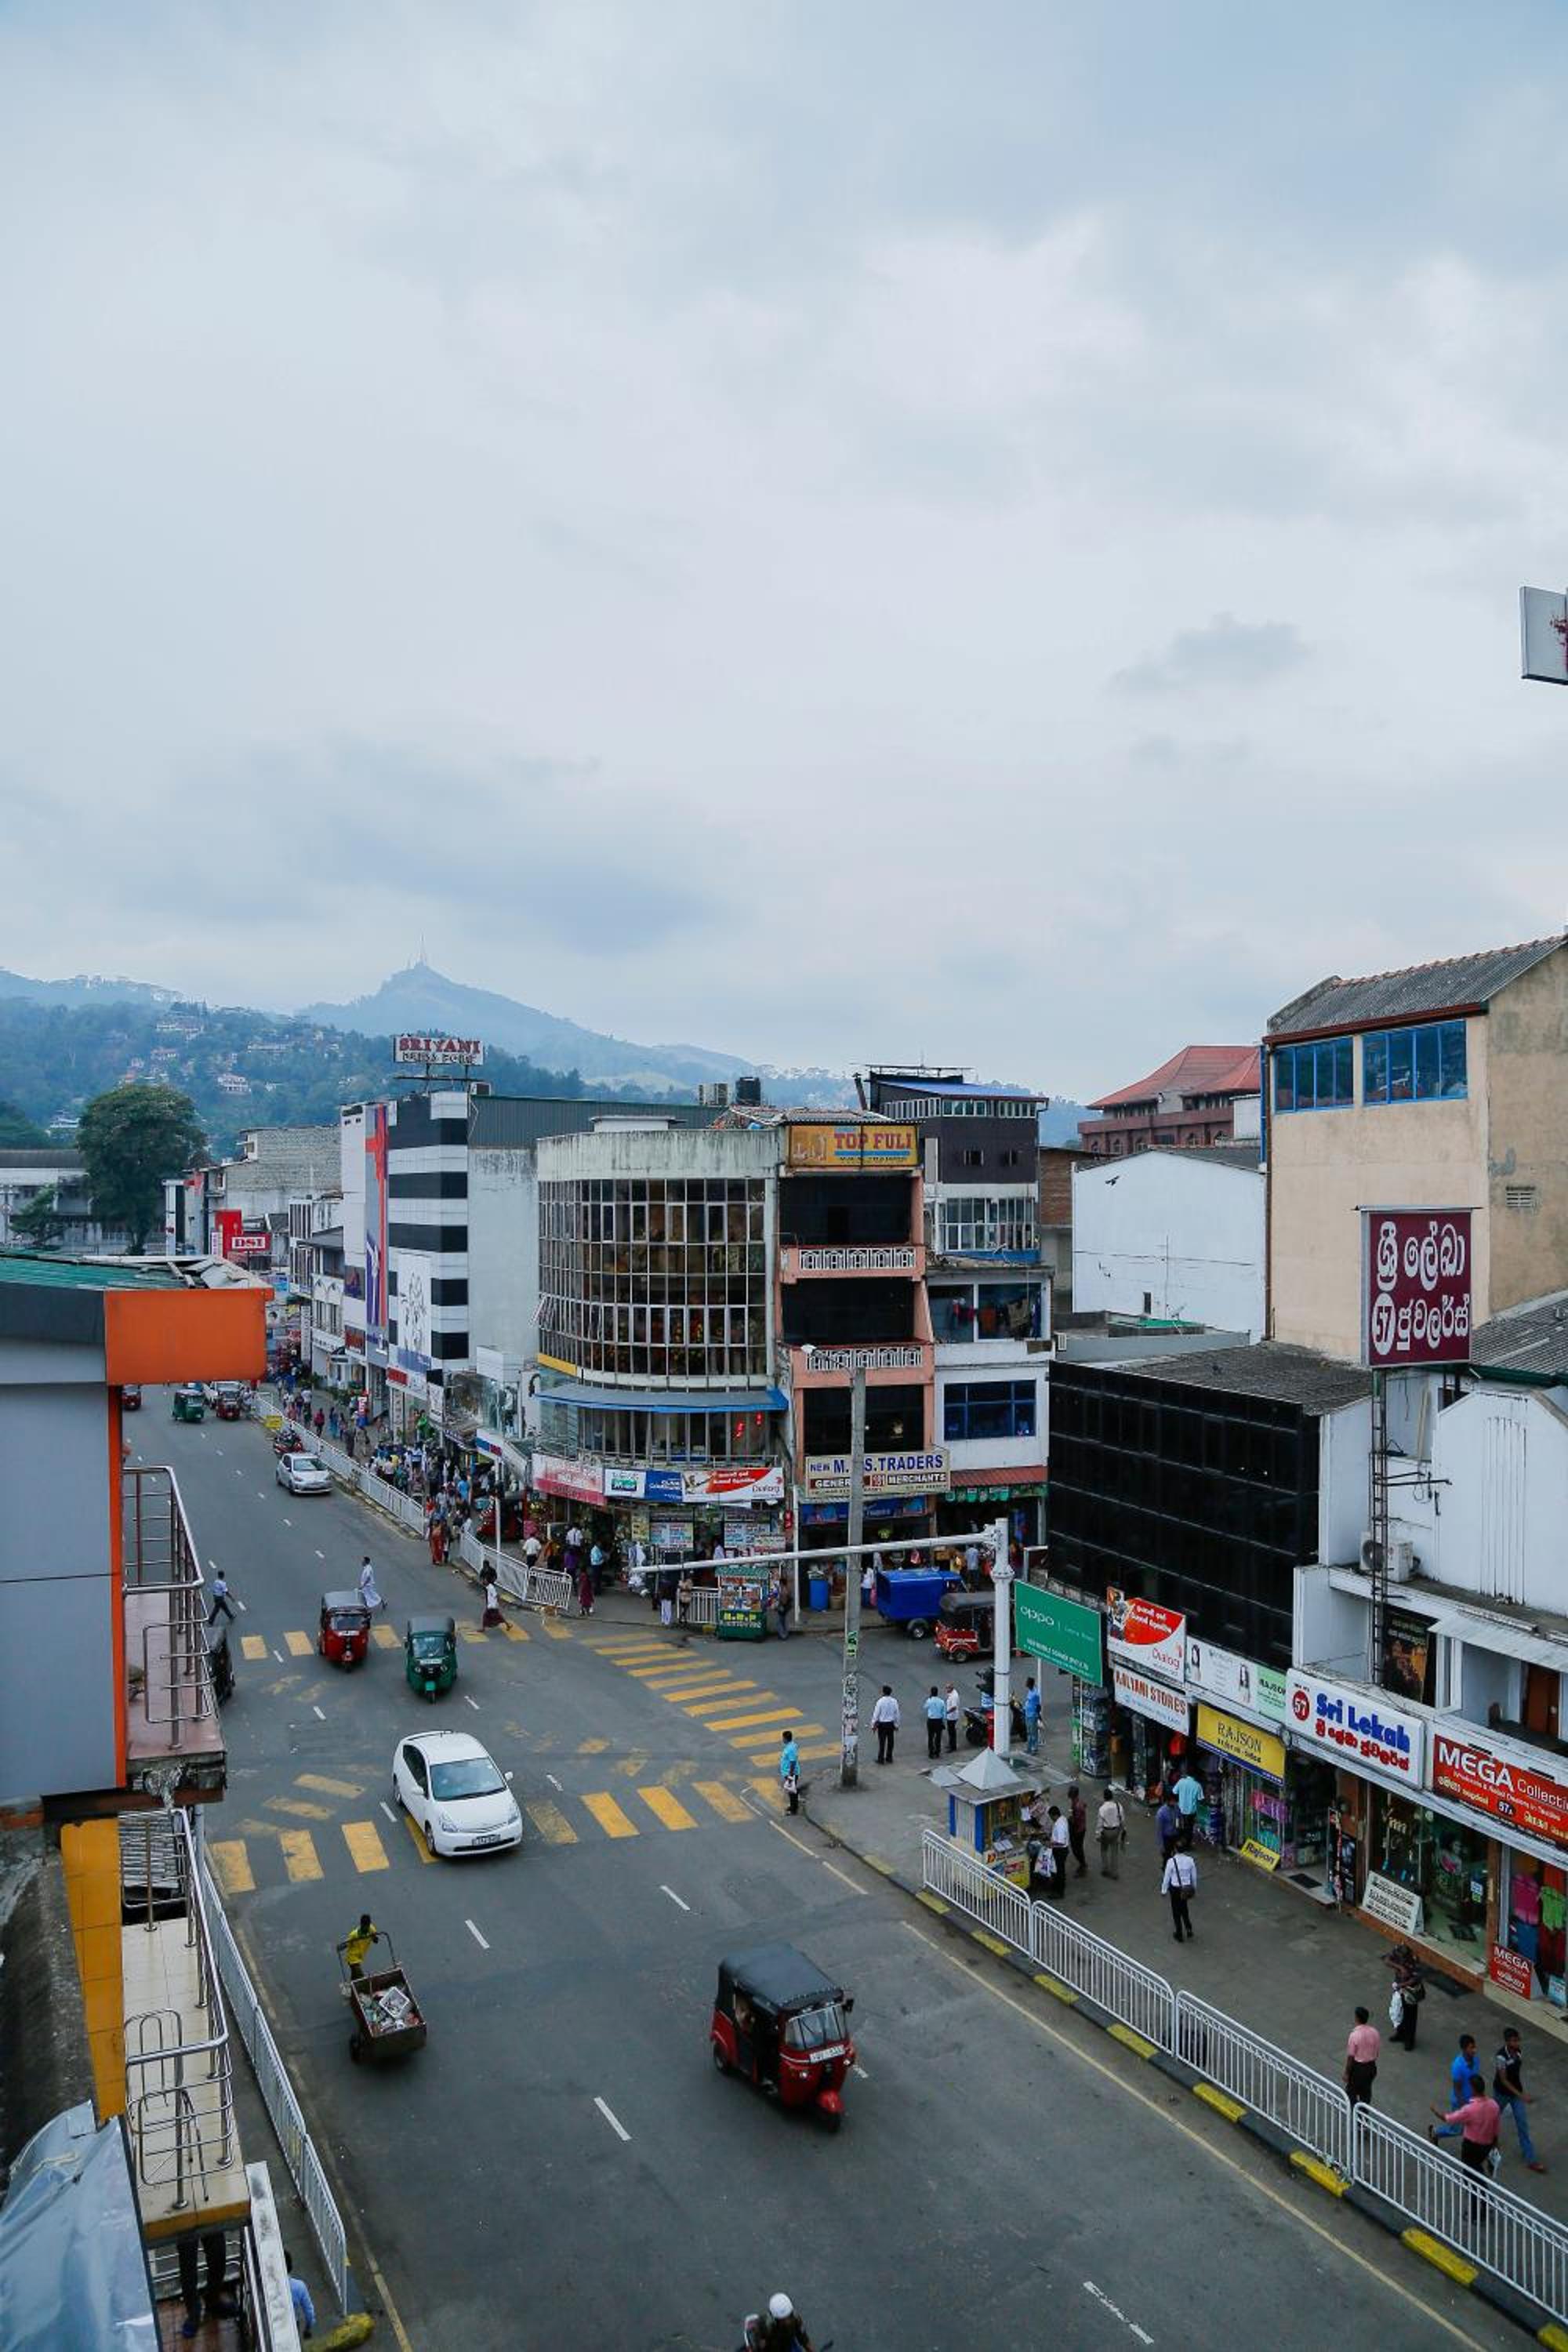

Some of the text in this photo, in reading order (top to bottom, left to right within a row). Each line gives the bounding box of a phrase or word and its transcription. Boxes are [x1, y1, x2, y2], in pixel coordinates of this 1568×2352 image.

[399, 1037, 481, 1054] SRIYANI
[834, 1133, 868, 1149] TOP
[235, 1238, 263, 1247] DSI
[1376, 1305, 1392, 1343] 57
[888, 1473, 946, 1485] MERCHANTS
[1020, 1605, 1054, 1626] oppo
[1150, 1686, 1186, 1715] STORES
[1294, 1701, 1307, 1718] 57
[1316, 1693, 1343, 1723] Sri
[1218, 1721, 1262, 1753] RAJSON
[1439, 1741, 1515, 1793] MEGA
[1517, 1778, 1568, 1810] Collecti
[1494, 1946, 1530, 1973] MEGA
